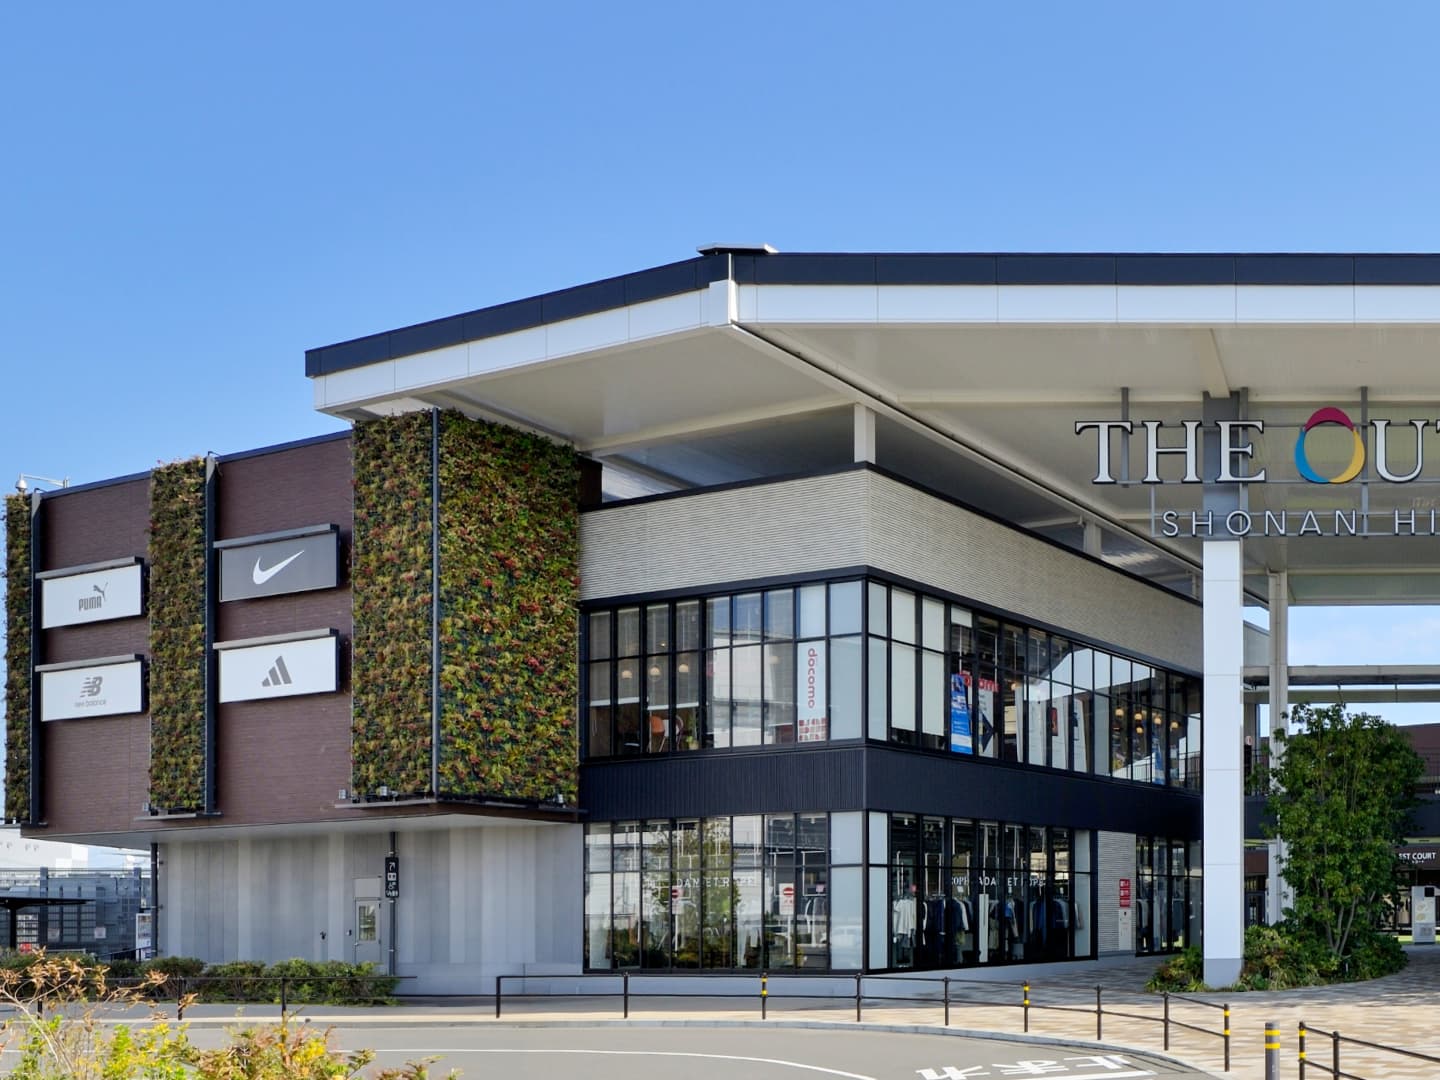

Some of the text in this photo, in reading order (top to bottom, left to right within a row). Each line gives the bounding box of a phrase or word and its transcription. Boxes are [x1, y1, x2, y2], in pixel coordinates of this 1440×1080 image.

[1074, 419, 1267, 485] THE
[1161, 509, 1359, 538] SHONAN
[78, 595, 102, 611] PUMA
[807, 647, 818, 709] docomo
[1412, 852, 1437, 860] COURT
